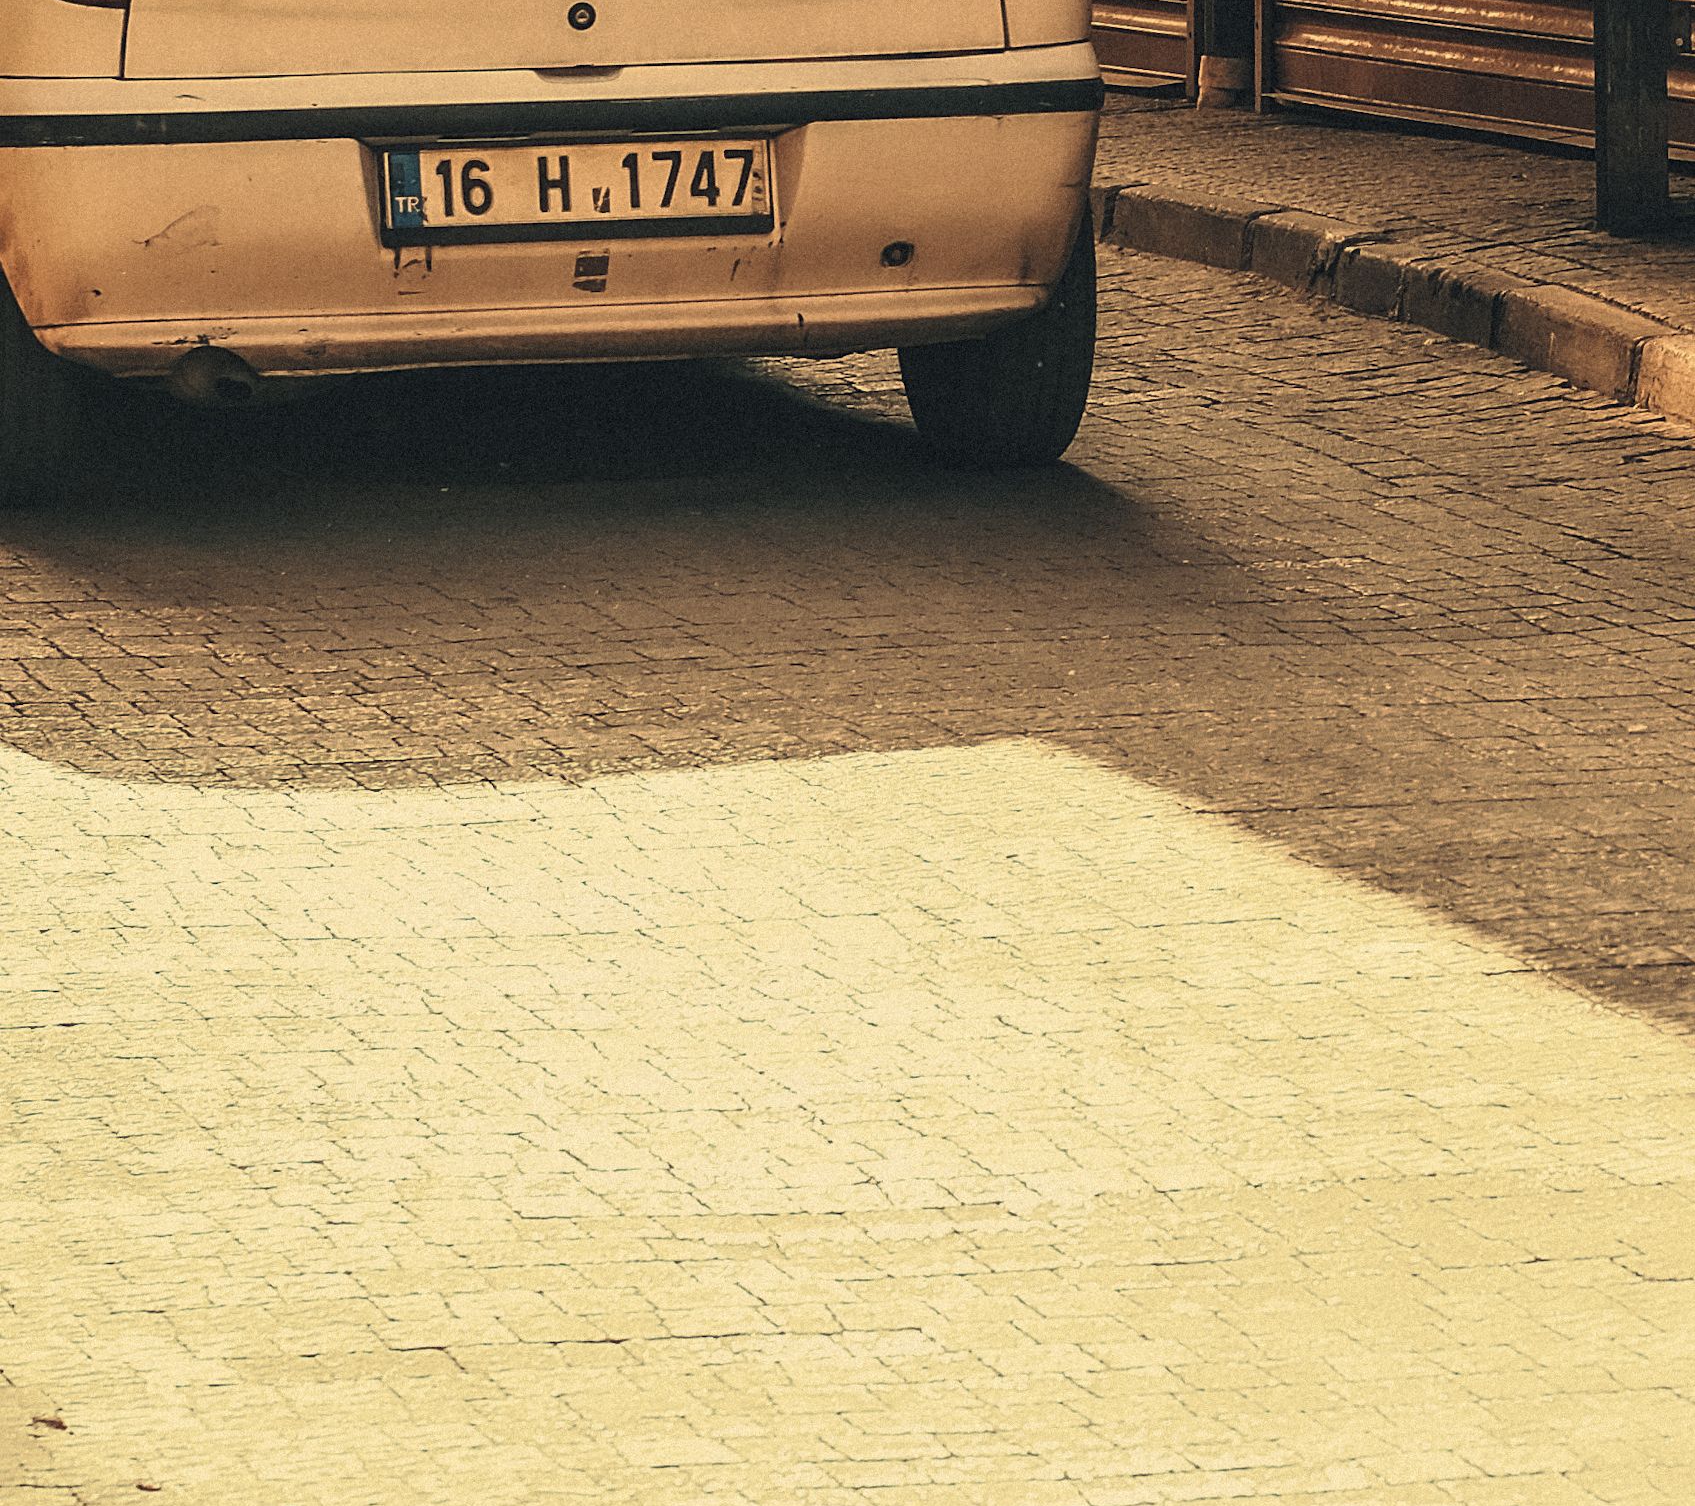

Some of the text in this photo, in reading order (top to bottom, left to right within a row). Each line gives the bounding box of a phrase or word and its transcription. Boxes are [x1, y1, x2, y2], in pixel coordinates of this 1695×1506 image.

[395, 149, 755, 217] TR 16 H 1747
